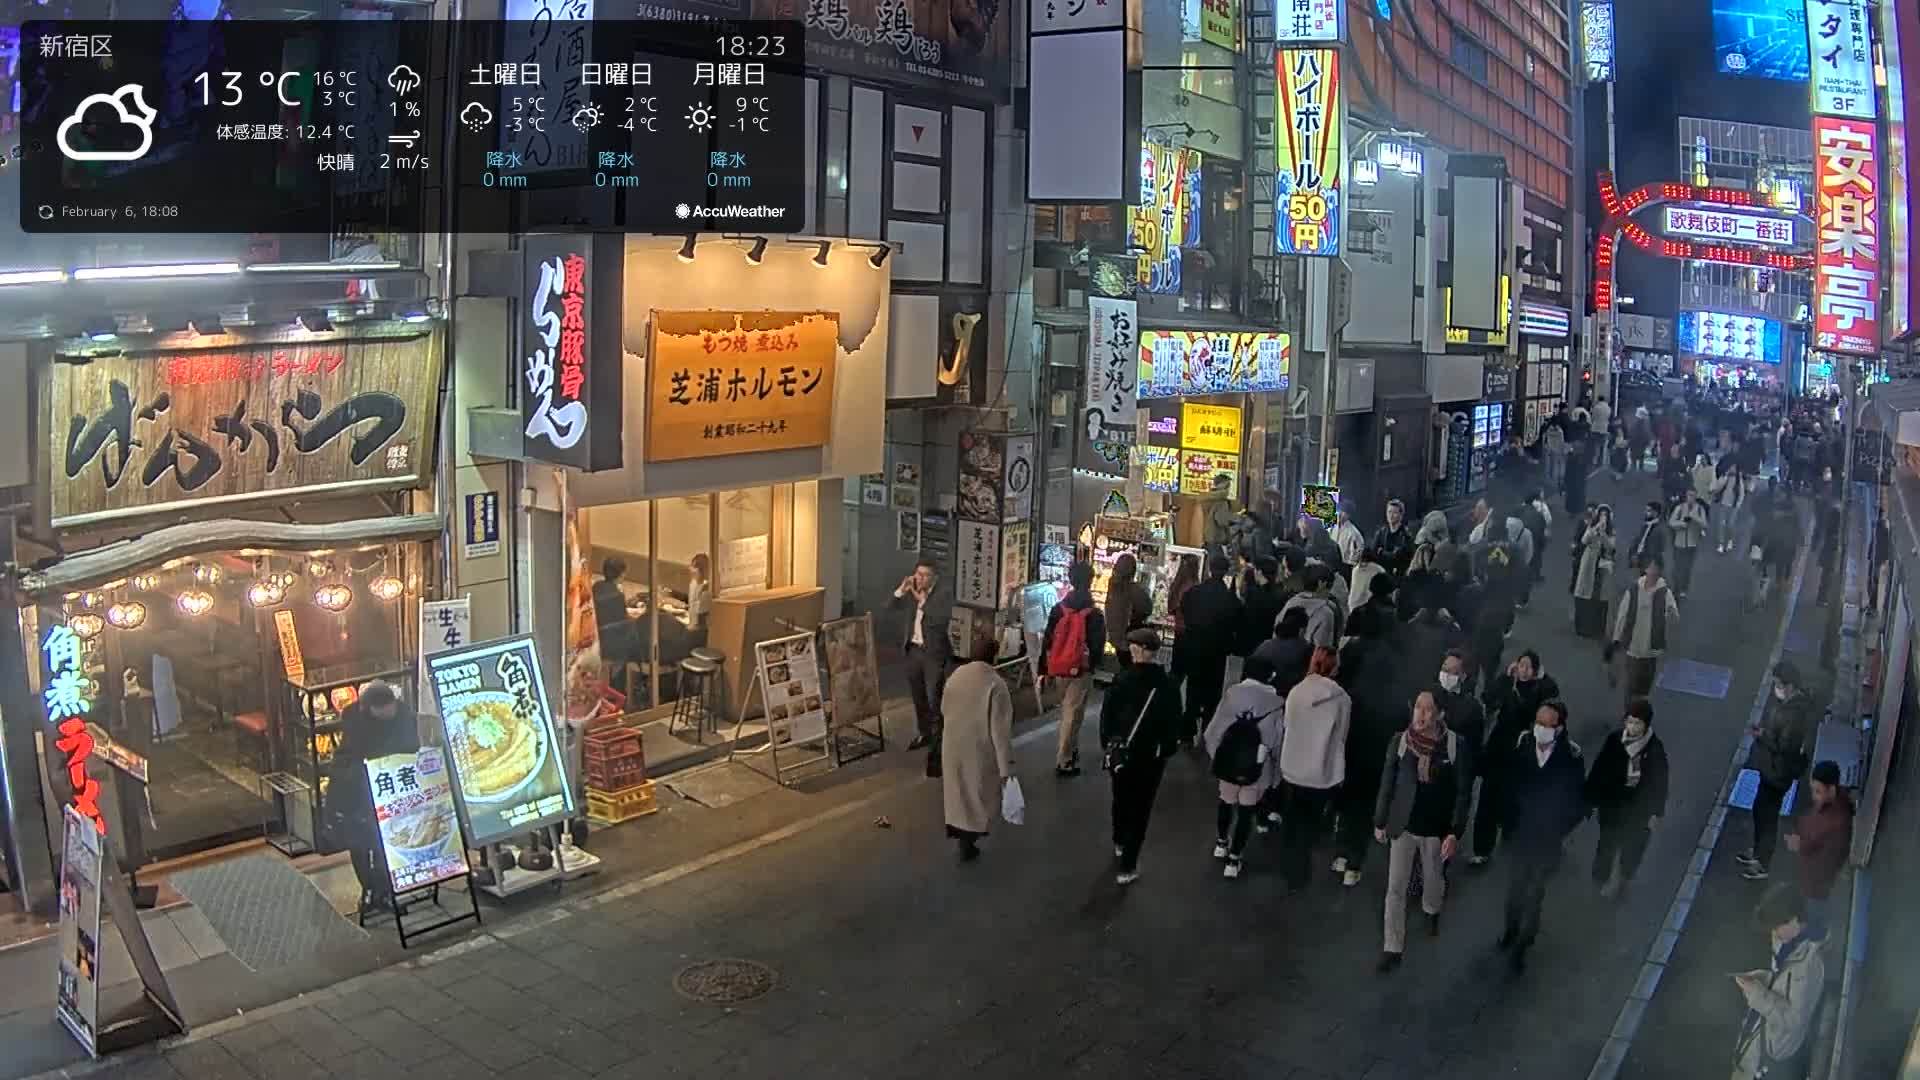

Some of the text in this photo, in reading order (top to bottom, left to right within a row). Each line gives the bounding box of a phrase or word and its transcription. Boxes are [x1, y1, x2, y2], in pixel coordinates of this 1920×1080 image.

[1589, 62, 1610, 79] 7F
[1833, 97, 1856, 111] 3F
[1294, 52, 1322, 192] ハイボール
[1289, 194, 1327, 221] 50
[1294, 222, 1321, 250] 円
[1670, 211, 1790, 242] 歌舞伎町一番街
[1820, 125, 1874, 330] 安楽亭
[561, 253, 586, 399] 東京豚骨
[1818, 332, 1837, 347] 2F
[755, 332, 799, 352] 煮込み
[1104, 308, 1135, 413] お好み焼き
[668, 366, 823, 405] 芝浦ホルモン
[65, 379, 408, 491] ばんから
[434, 662, 480, 684] TOKYO
[437, 676, 482, 696] RAMEN
[374, 766, 420, 798] 角煮
